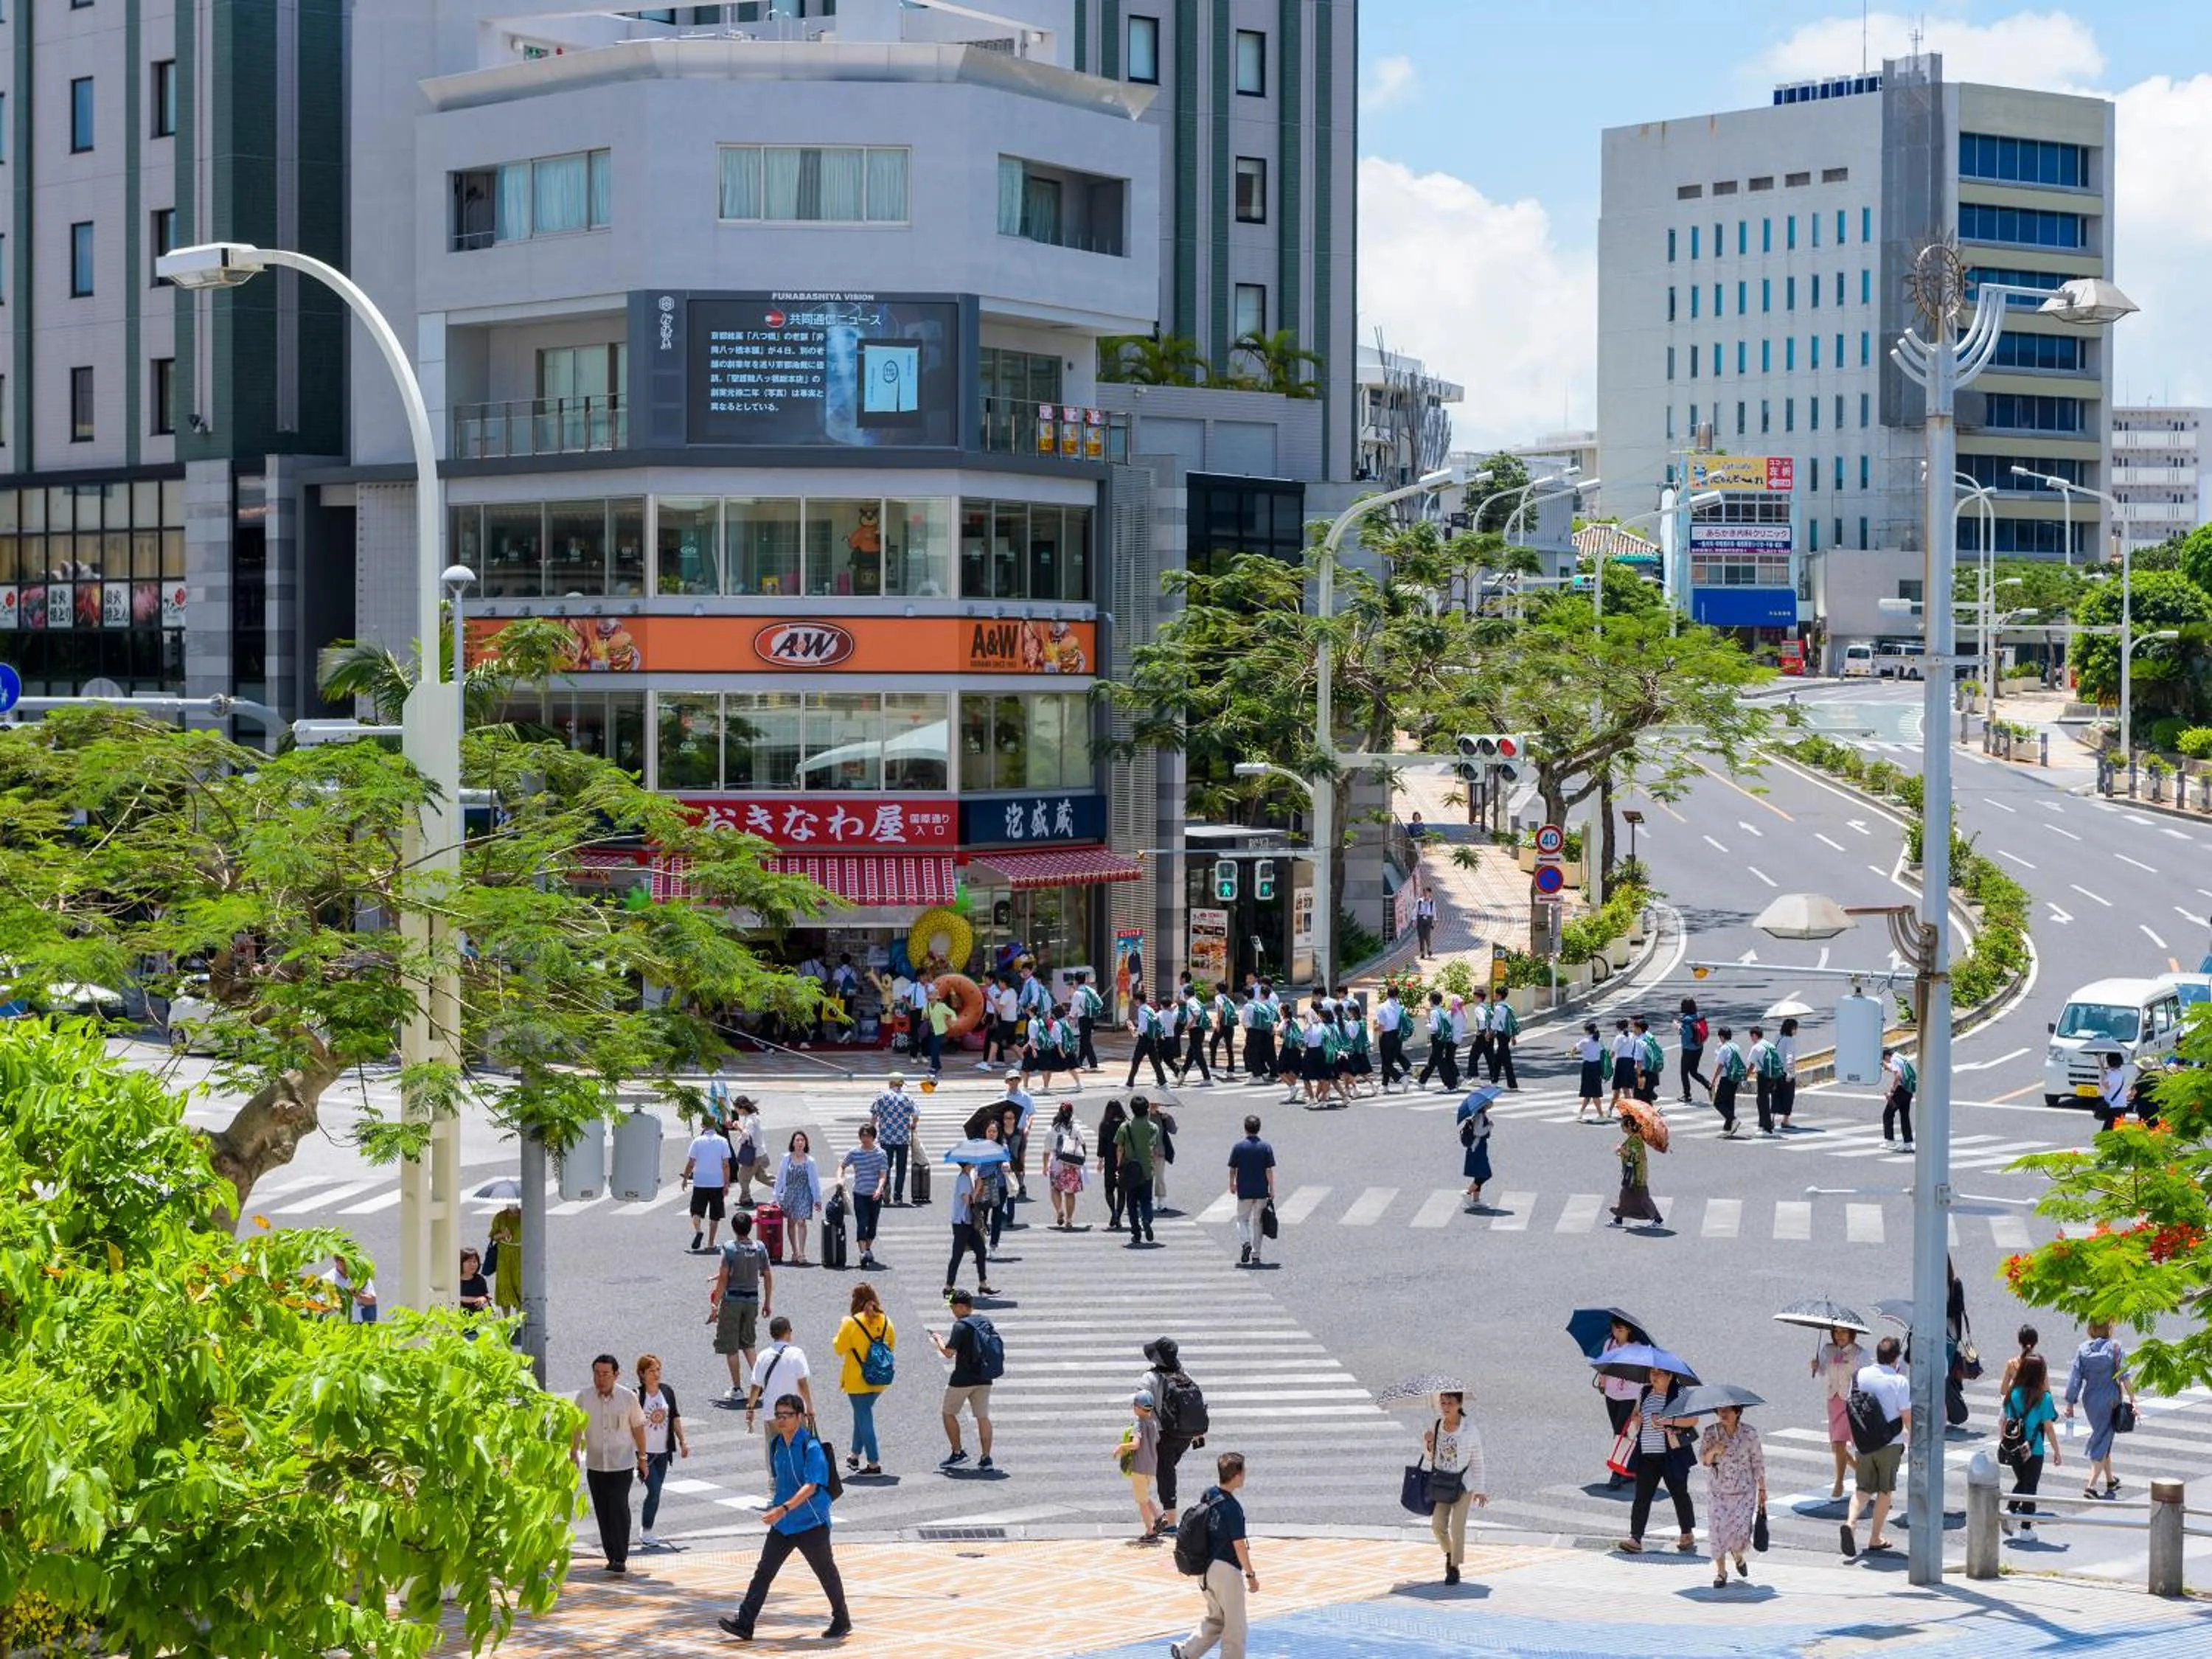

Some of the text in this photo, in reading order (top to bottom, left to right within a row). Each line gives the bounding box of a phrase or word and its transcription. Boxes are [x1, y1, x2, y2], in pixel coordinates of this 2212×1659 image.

[771, 292, 875, 301] FUNABASHIYA VISION
[789, 313, 882, 326] 共同通信ニュース
[1706, 529, 1787, 538] あらかき内科クリニック
[773, 633, 840, 658] A&W
[970, 622, 1019, 658] A&W
[703, 804, 907, 843] おきなわ屋
[915, 825, 945, 836] 入口
[1542, 832, 1558, 846] 40
